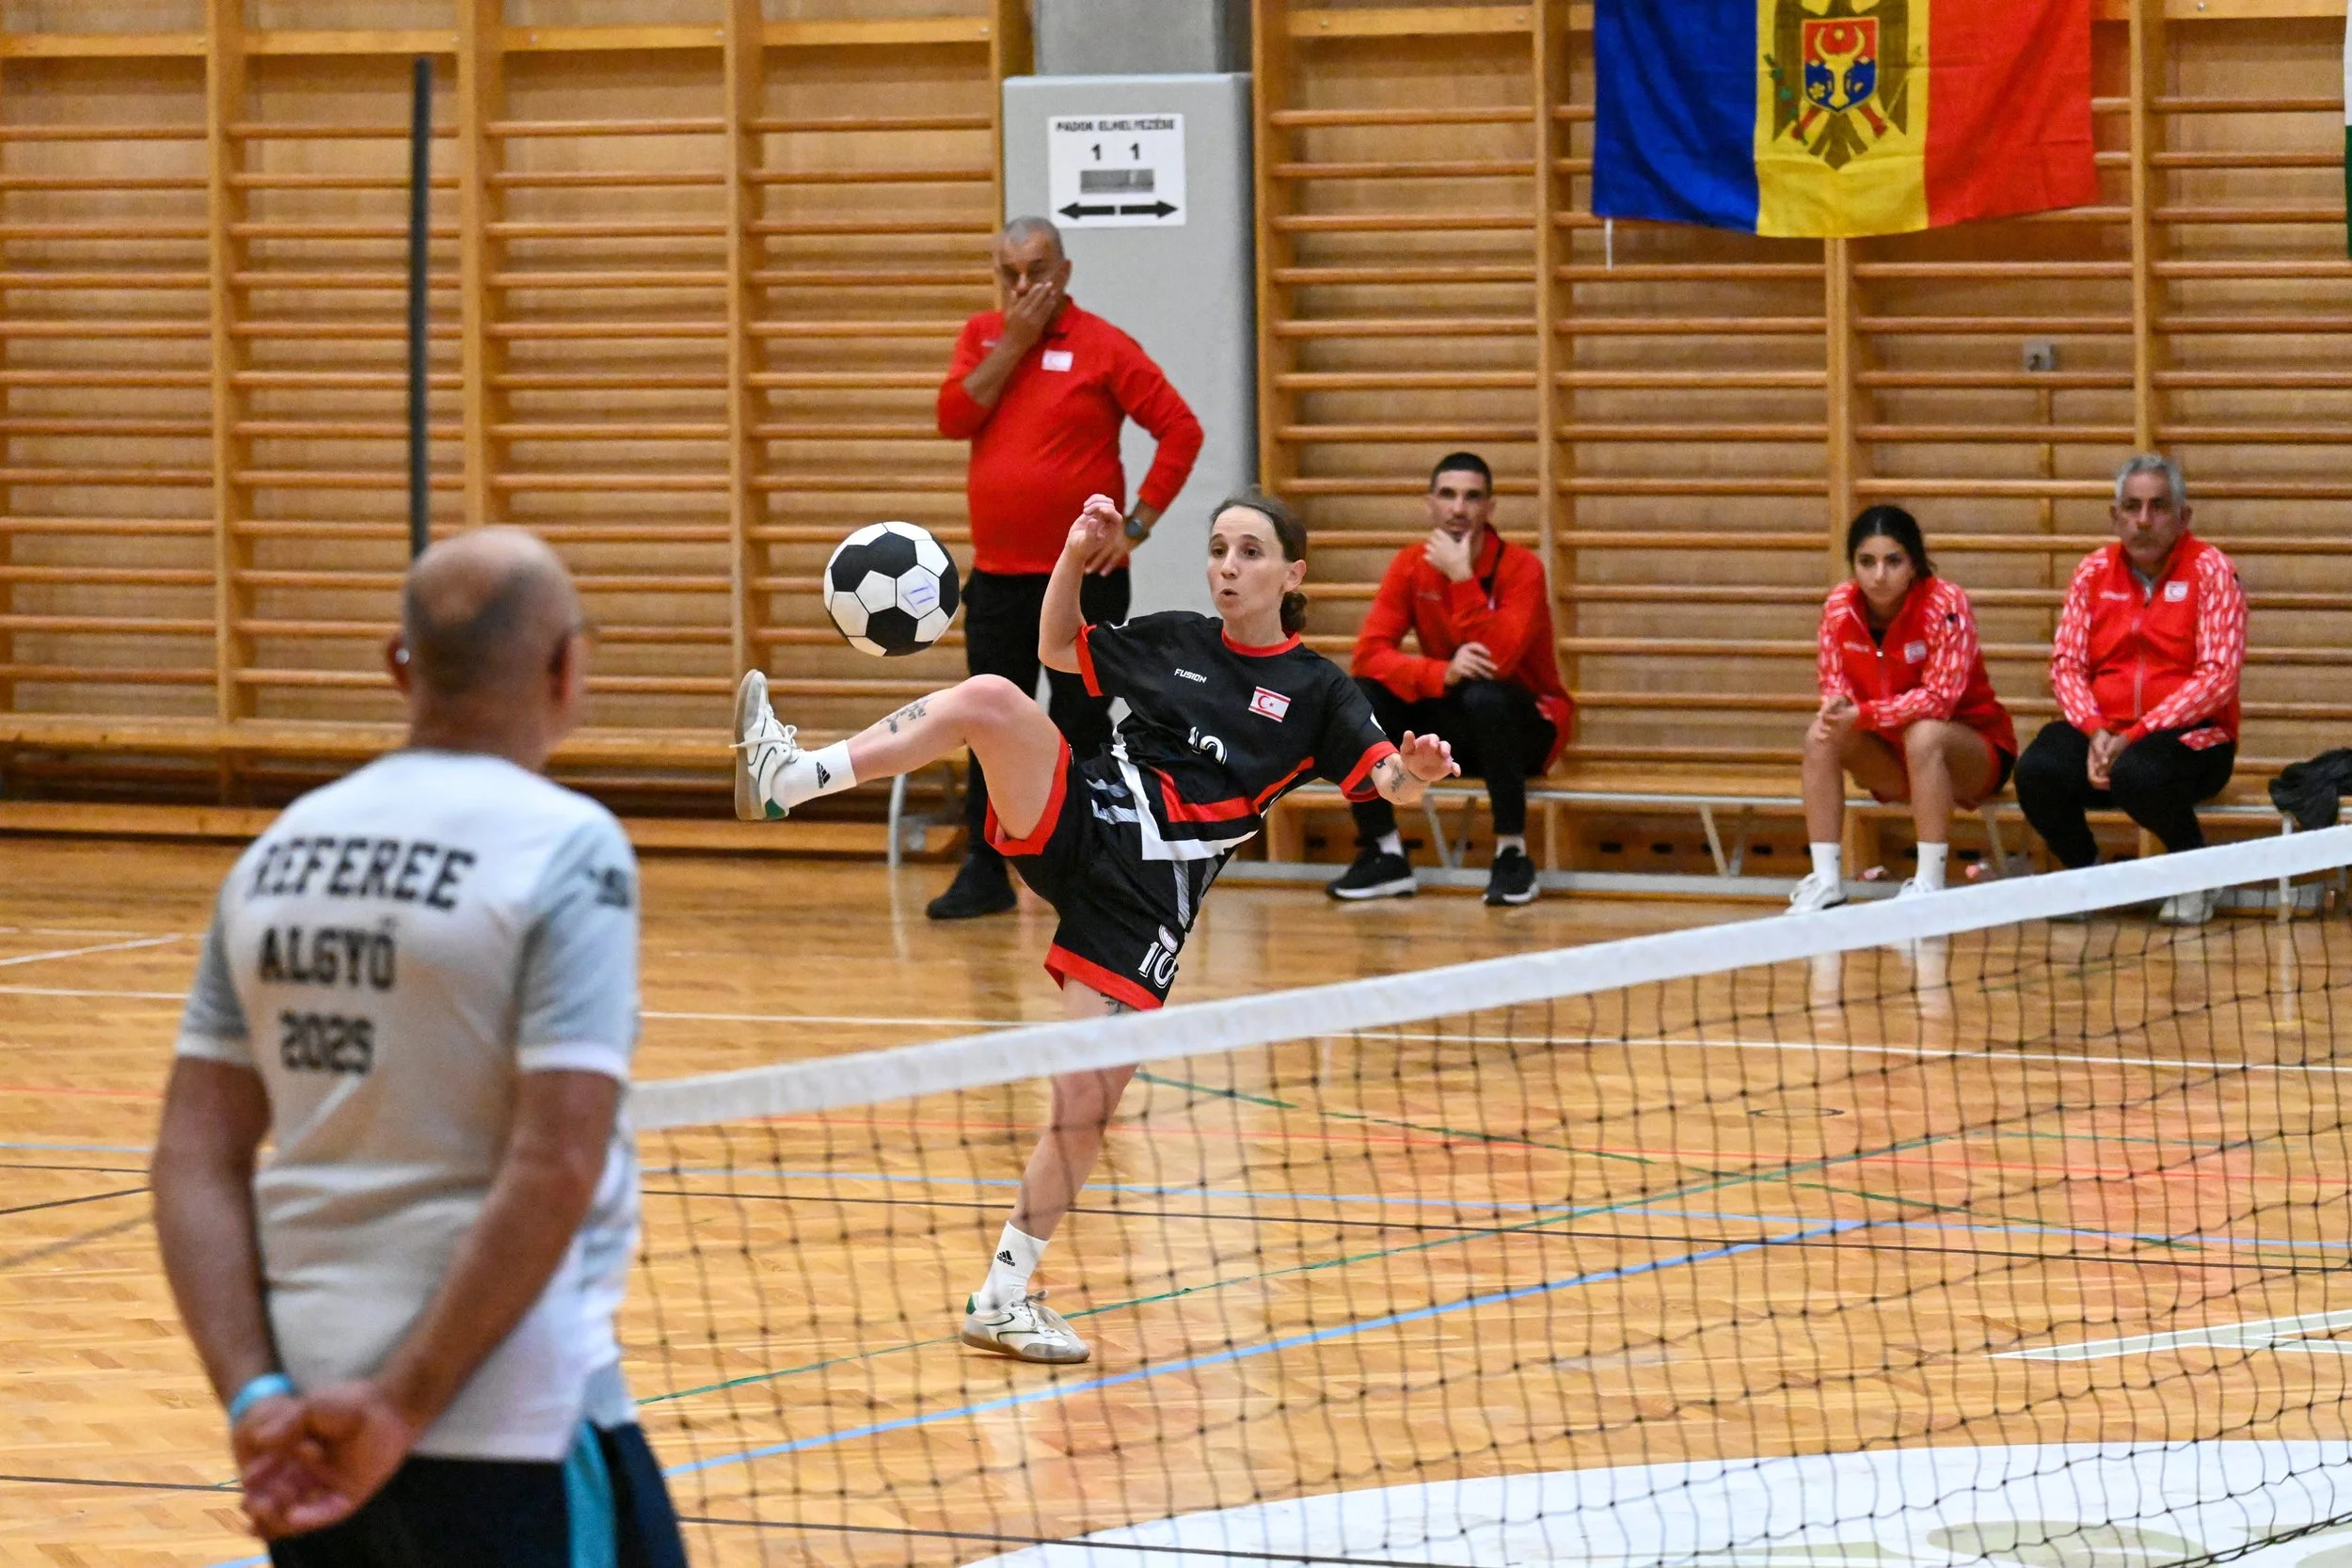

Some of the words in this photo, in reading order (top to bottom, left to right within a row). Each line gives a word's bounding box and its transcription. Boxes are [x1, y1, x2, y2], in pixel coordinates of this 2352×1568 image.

[1091, 143, 1101, 160] 1
[1130, 142, 1139, 160] 1
[1174, 668, 1207, 683] FUSION
[247, 836, 474, 910] REFEREE
[1138, 942, 1176, 988] 10
[280, 1007, 373, 1074] 2025
